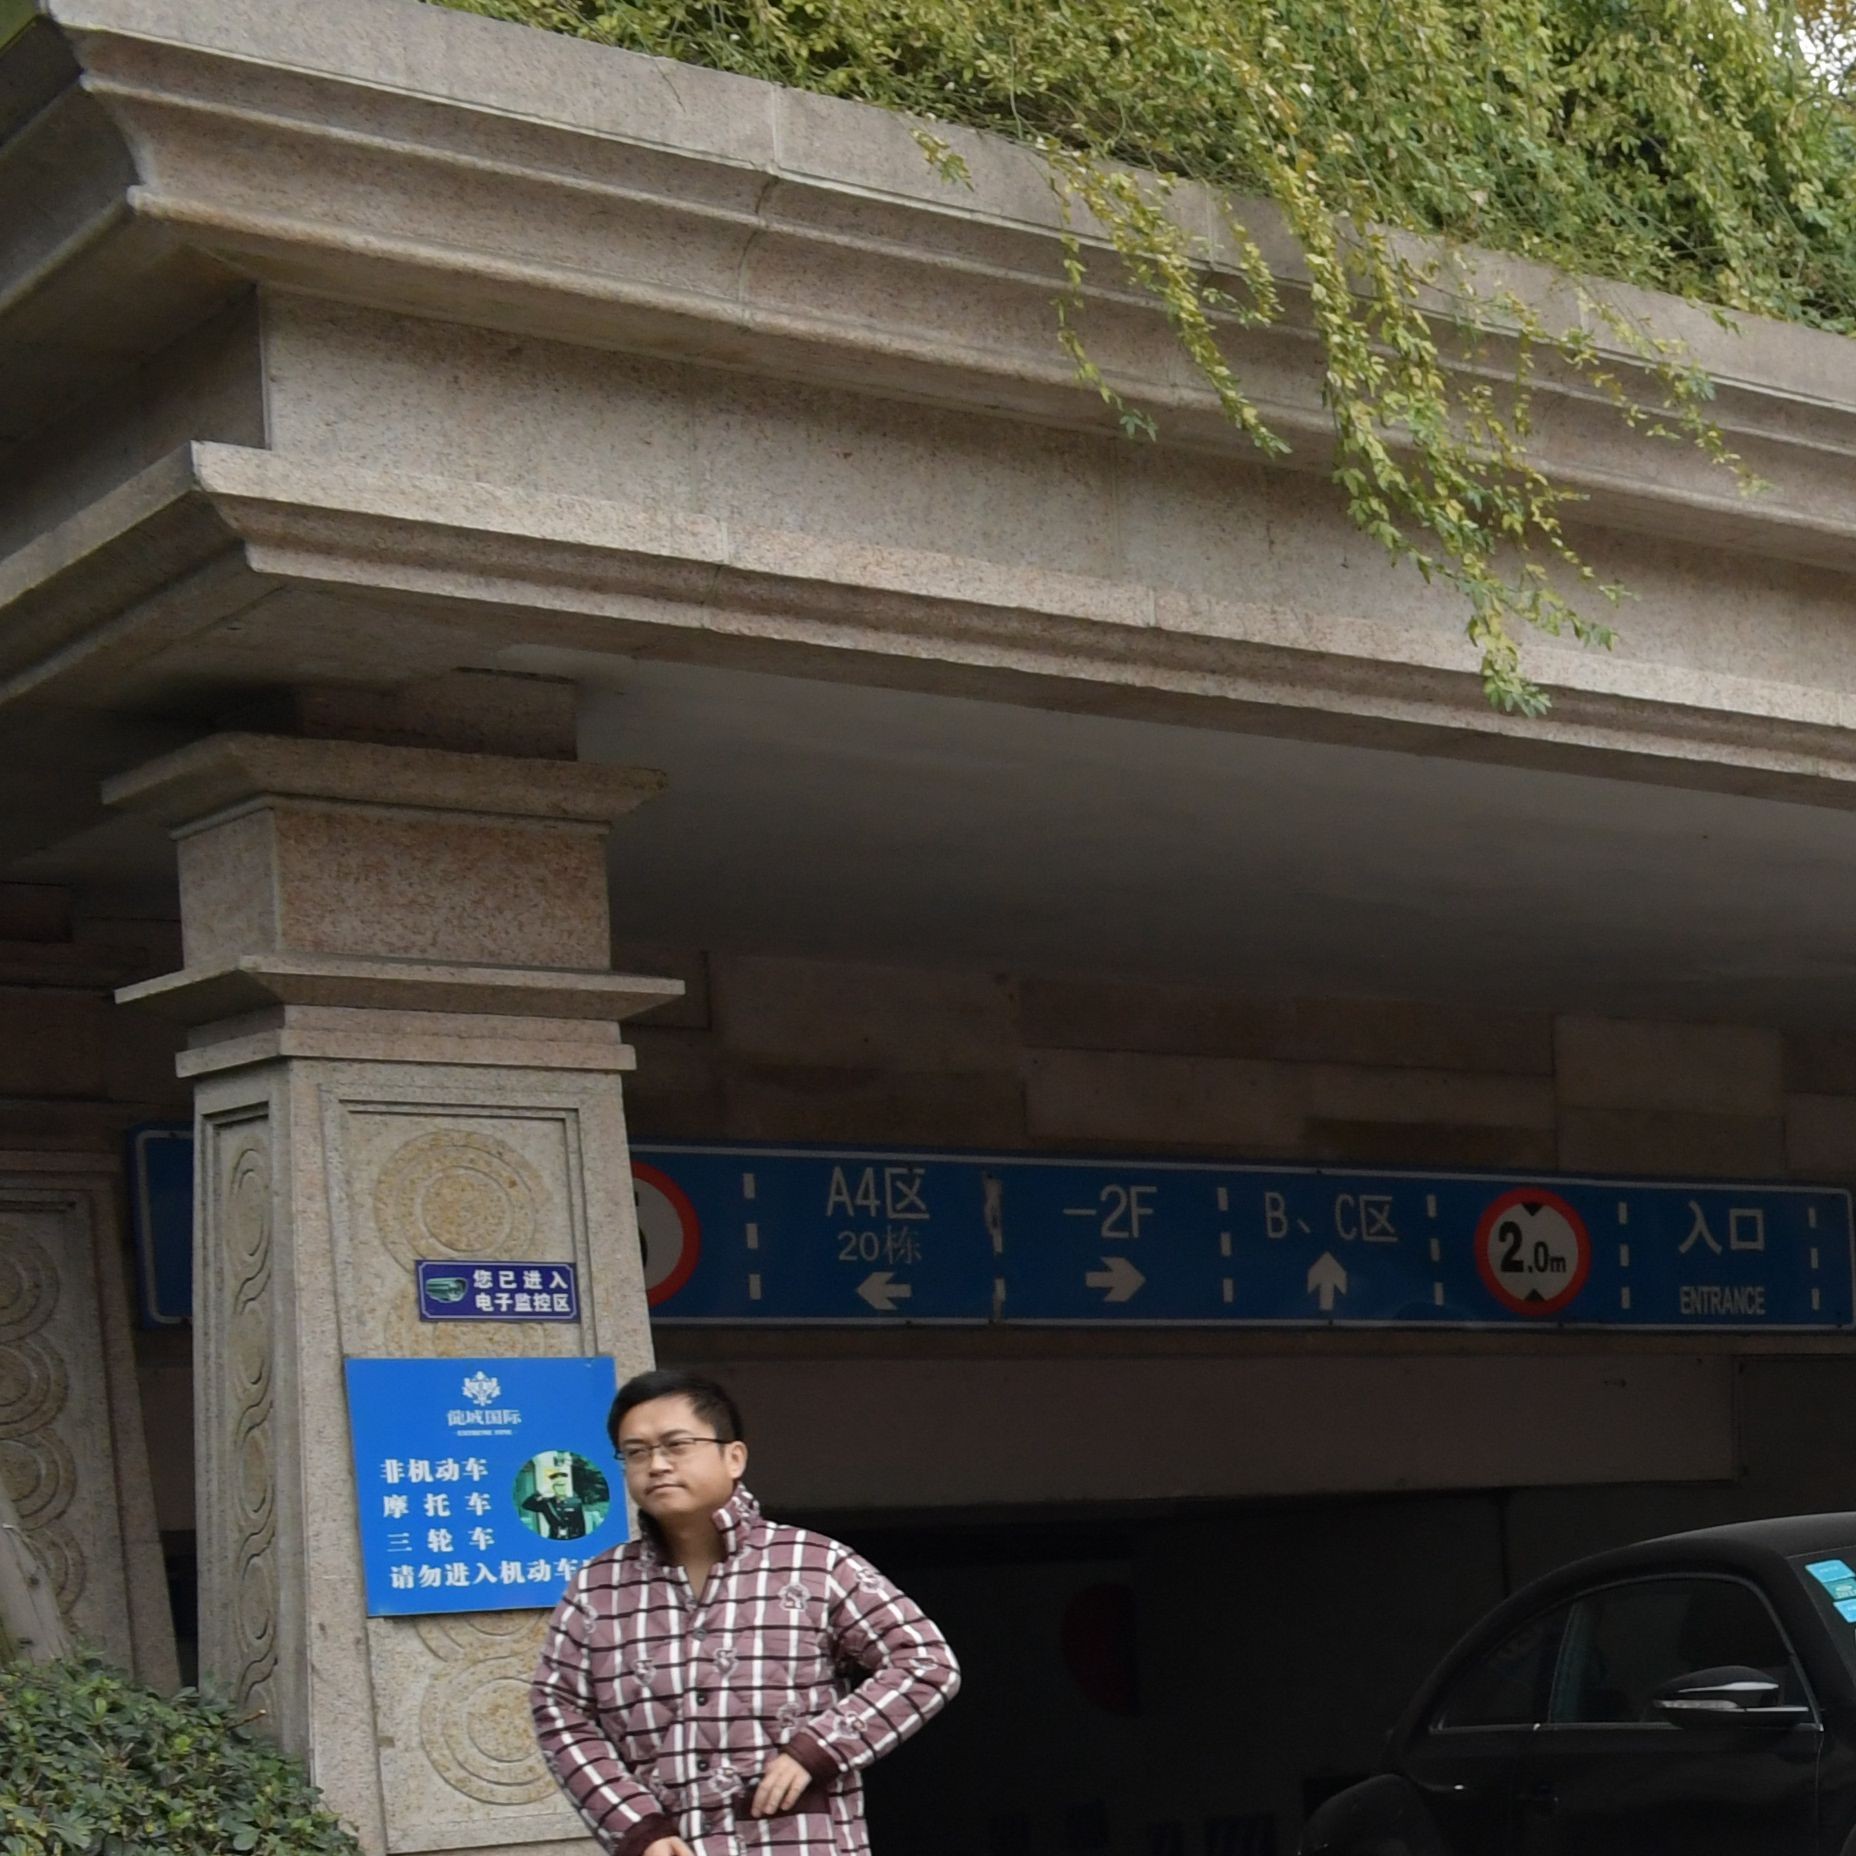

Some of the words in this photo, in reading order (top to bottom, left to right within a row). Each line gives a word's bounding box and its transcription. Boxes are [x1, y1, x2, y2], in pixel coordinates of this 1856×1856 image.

[826, 1166, 931, 1221] A4区
[1678, 1201, 1765, 1255] 入口
[838, 1225, 922, 1265] 20栋
[1498, 1221, 1567, 1275] 2.0m
[473, 1269, 568, 1290] 您已进入
[475, 1293, 570, 1313] 电子监控区
[1680, 1285, 1766, 1316] ENTRANCE
[380, 1457, 488, 1484] 非机动车
[383, 1492, 492, 1518] 摩托车
[386, 1527, 495, 1553] 三轮车
[390, 1557, 592, 1589] 请勿进入机动车
